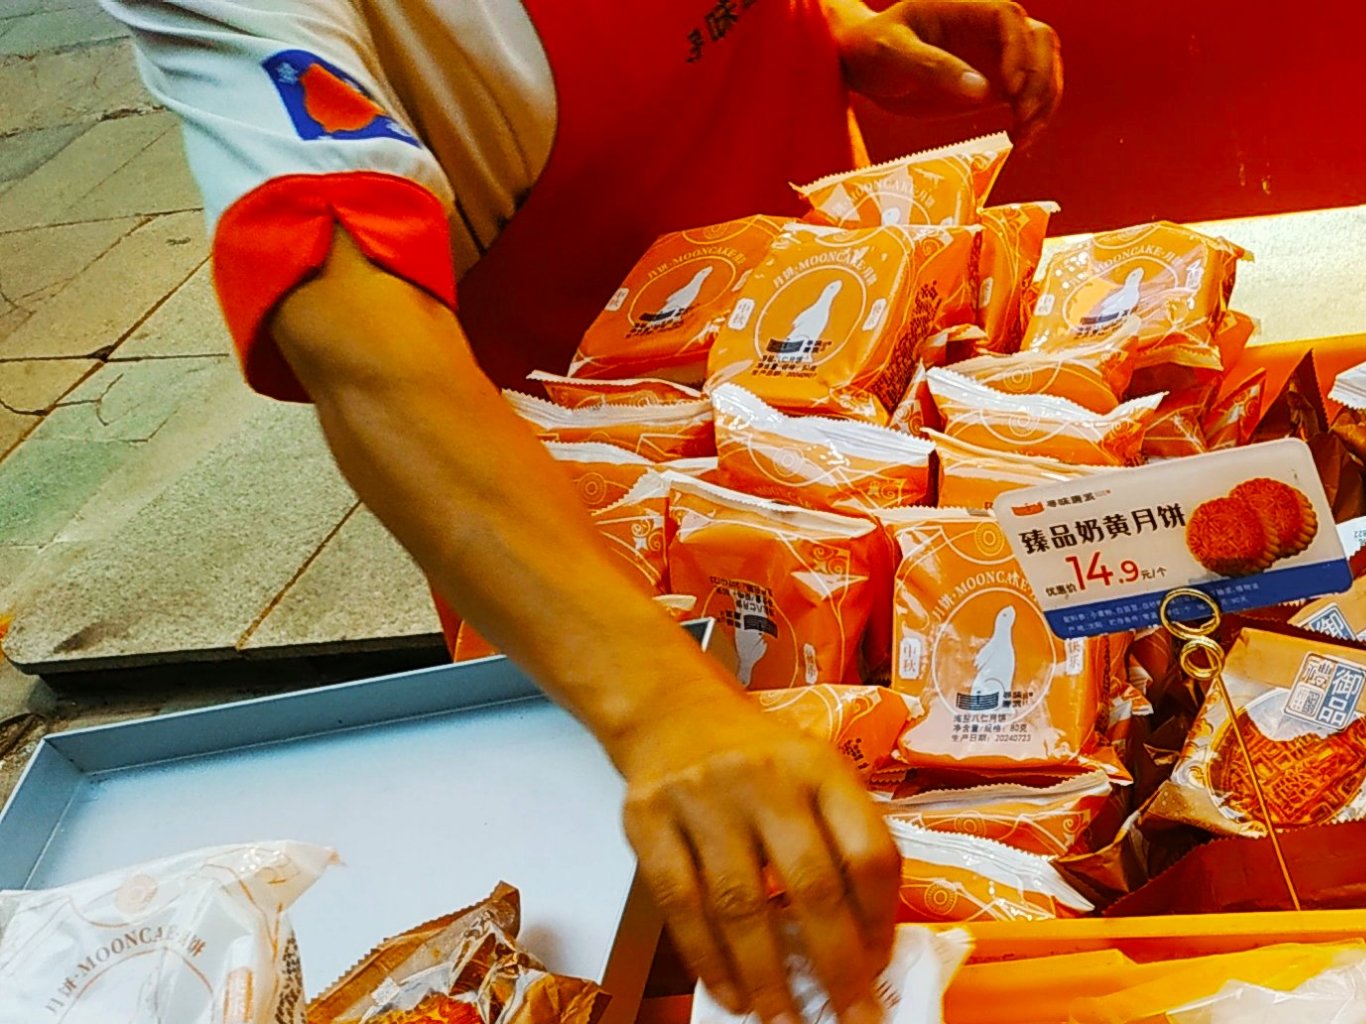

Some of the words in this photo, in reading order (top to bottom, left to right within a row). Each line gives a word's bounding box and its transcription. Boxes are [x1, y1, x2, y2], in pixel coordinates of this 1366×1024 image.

[1018, 502, 1187, 555] 臻品奶黄月饼
[931, 570, 1038, 623] 月饼·MOONCAKE·
[1045, 582, 1078, 598] 优惠价
[1065, 551, 1140, 591] 14.9
[903, 644, 916, 673] 中秋
[1318, 668, 1363, 727] 御品
